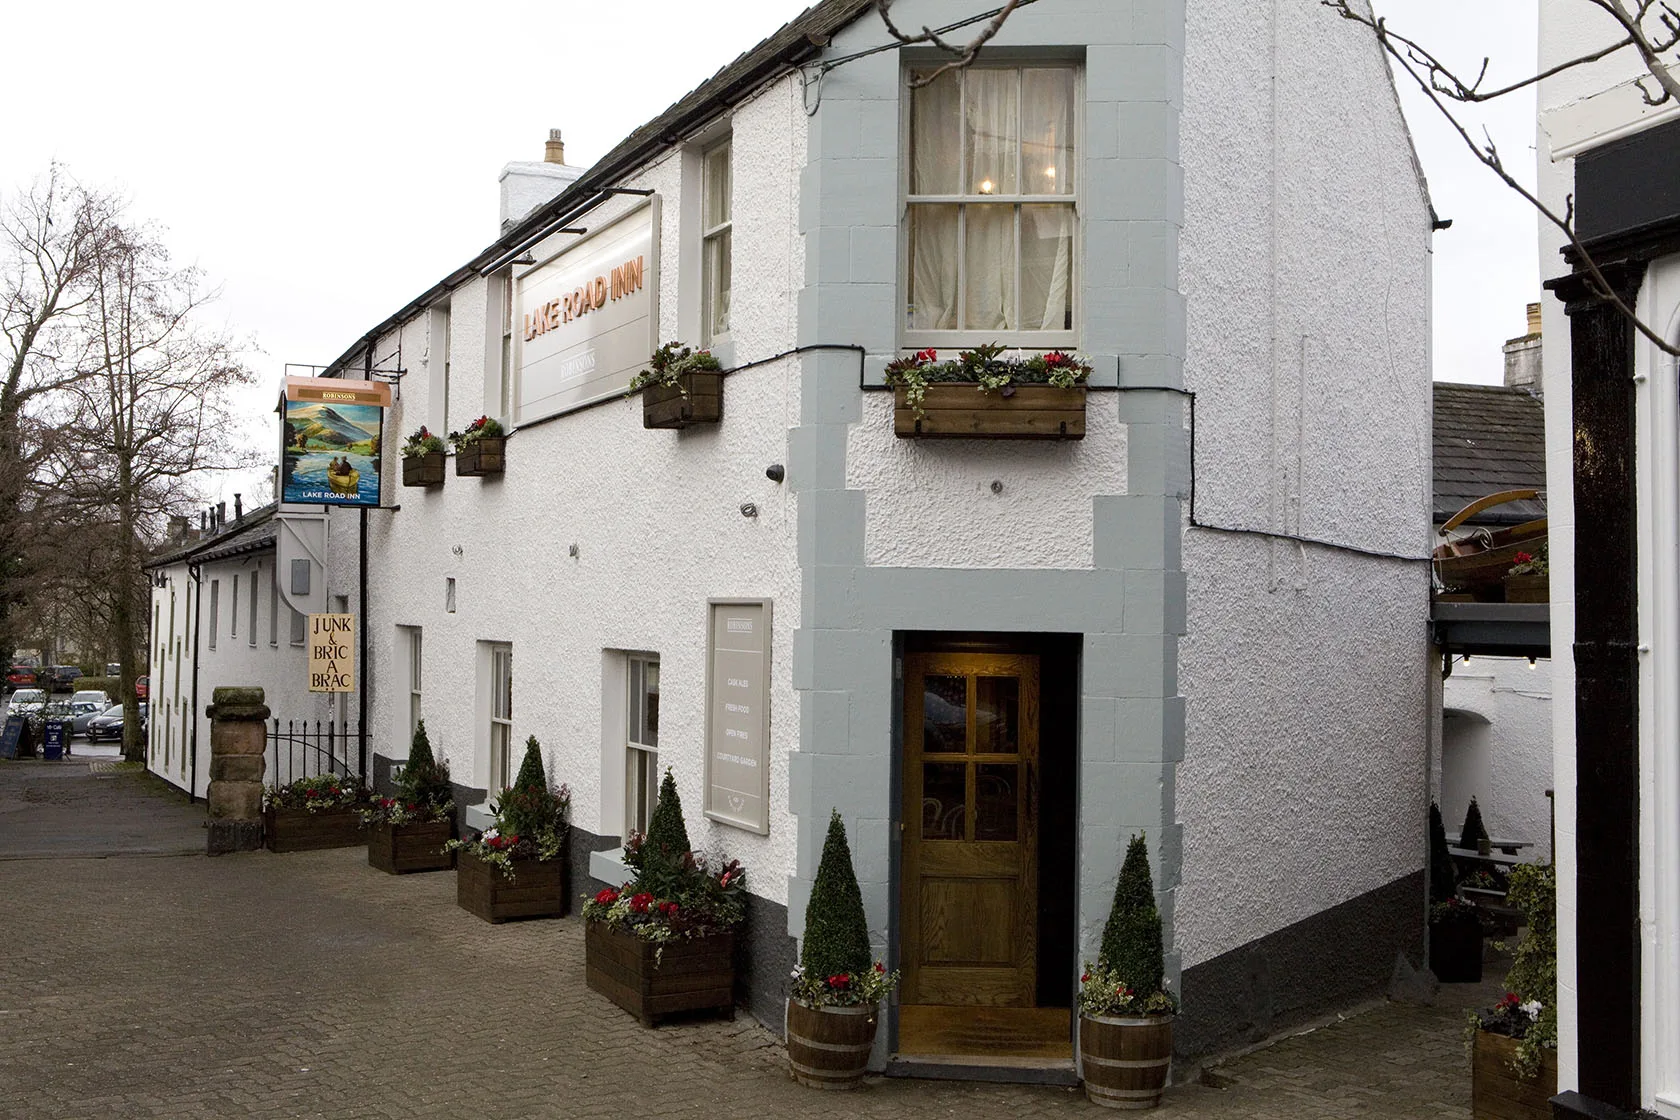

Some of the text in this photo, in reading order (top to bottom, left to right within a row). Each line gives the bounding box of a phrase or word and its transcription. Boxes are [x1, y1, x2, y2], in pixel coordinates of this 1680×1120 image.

[524, 256, 644, 342] LAKE ROAD INN
[322, 392, 356, 401] ROBINSONS
[302, 491, 322, 499] LAKE
[314, 617, 351, 634] JUNK
[328, 631, 338, 645] &
[314, 645, 348, 660] BRIC
[326, 660, 338, 673] A
[312, 673, 351, 688] BRAC
[738, 704, 750, 714] FOOD
[740, 756, 757, 767] GARDEN
